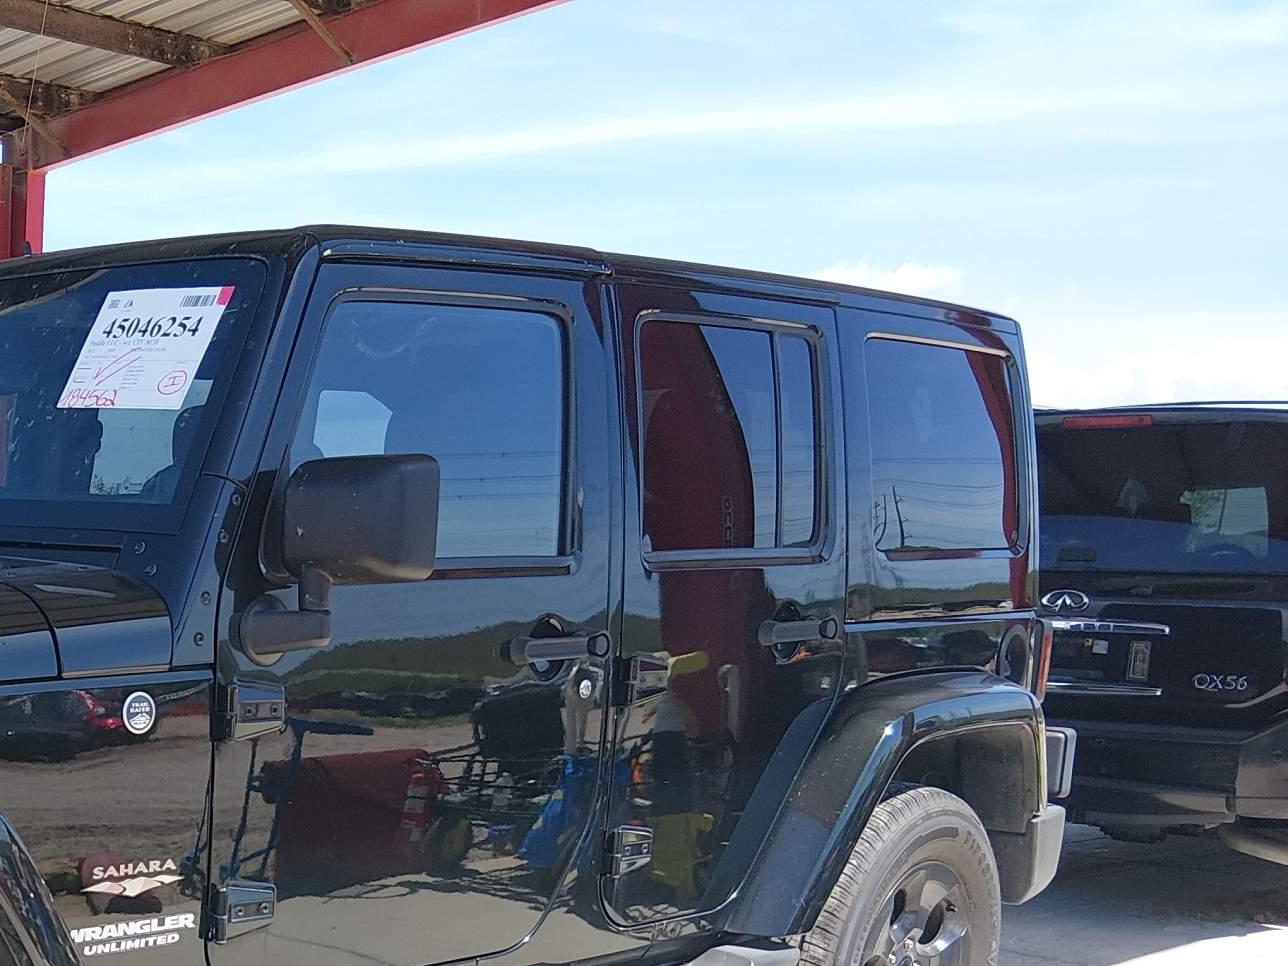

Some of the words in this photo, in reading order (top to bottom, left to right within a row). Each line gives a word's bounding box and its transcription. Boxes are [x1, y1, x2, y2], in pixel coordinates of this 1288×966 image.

[102, 315, 204, 338] 45046254
[1193, 673, 1248, 691] QX56
[92, 858, 177, 880] SAHARA
[70, 913, 196, 943] WRANGLER
[83, 932, 180, 956] UNLIMITED
